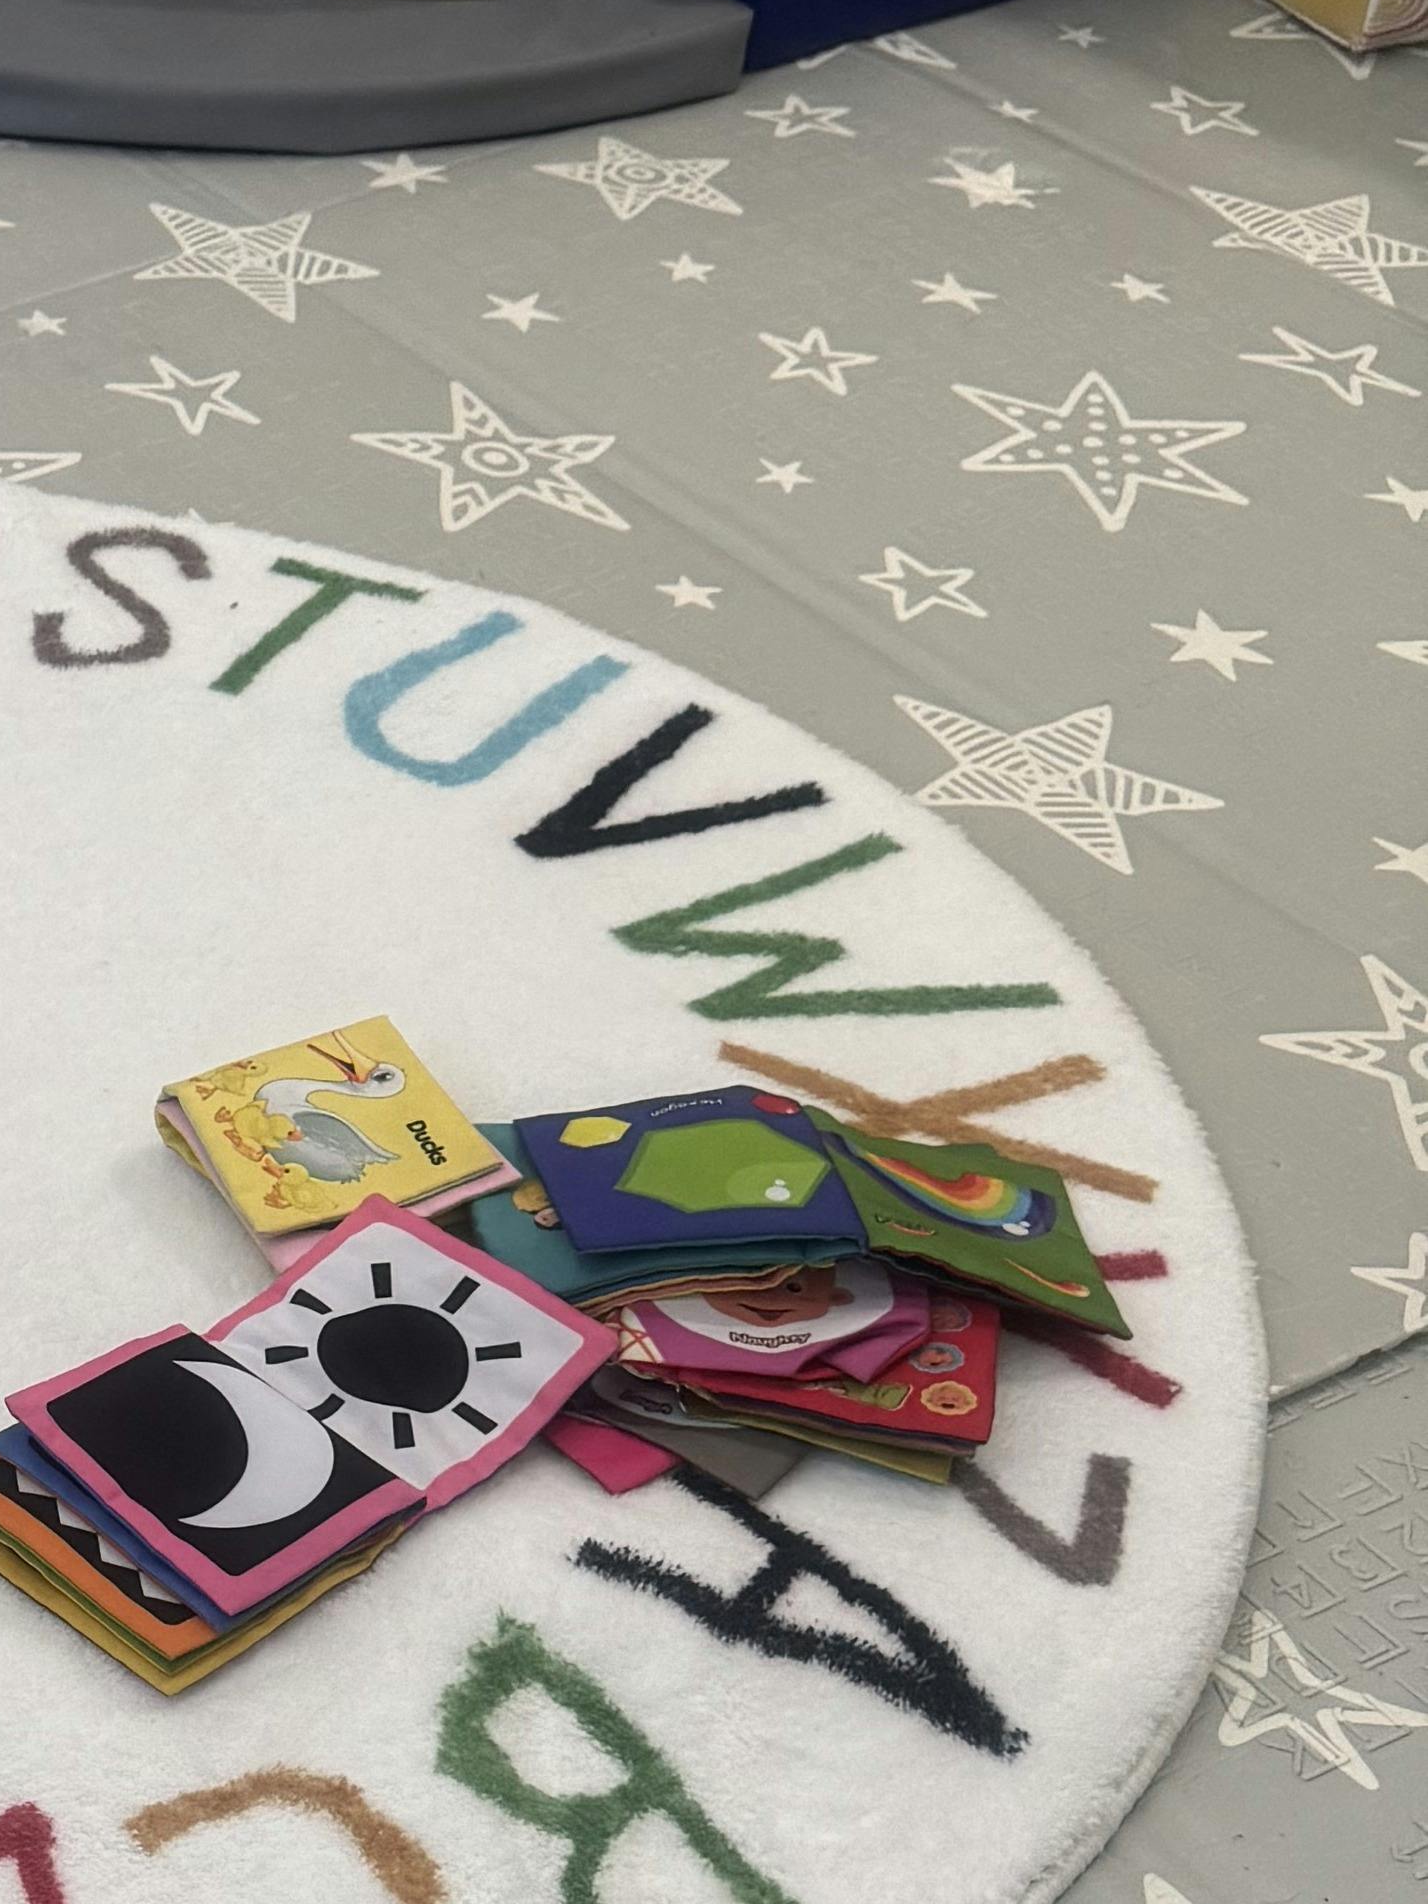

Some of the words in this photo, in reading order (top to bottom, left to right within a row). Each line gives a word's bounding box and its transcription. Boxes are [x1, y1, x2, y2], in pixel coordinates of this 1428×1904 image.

[32, 526, 213, 669] S
[208, 556, 429, 696] T
[343, 609, 634, 788] U
[513, 702, 834, 859] V
[608, 832, 1063, 1022] W
[405, 1119, 448, 1167] Ducks
[717, 1039, 1159, 1202] X
[569, 1462, 1030, 1760] A
